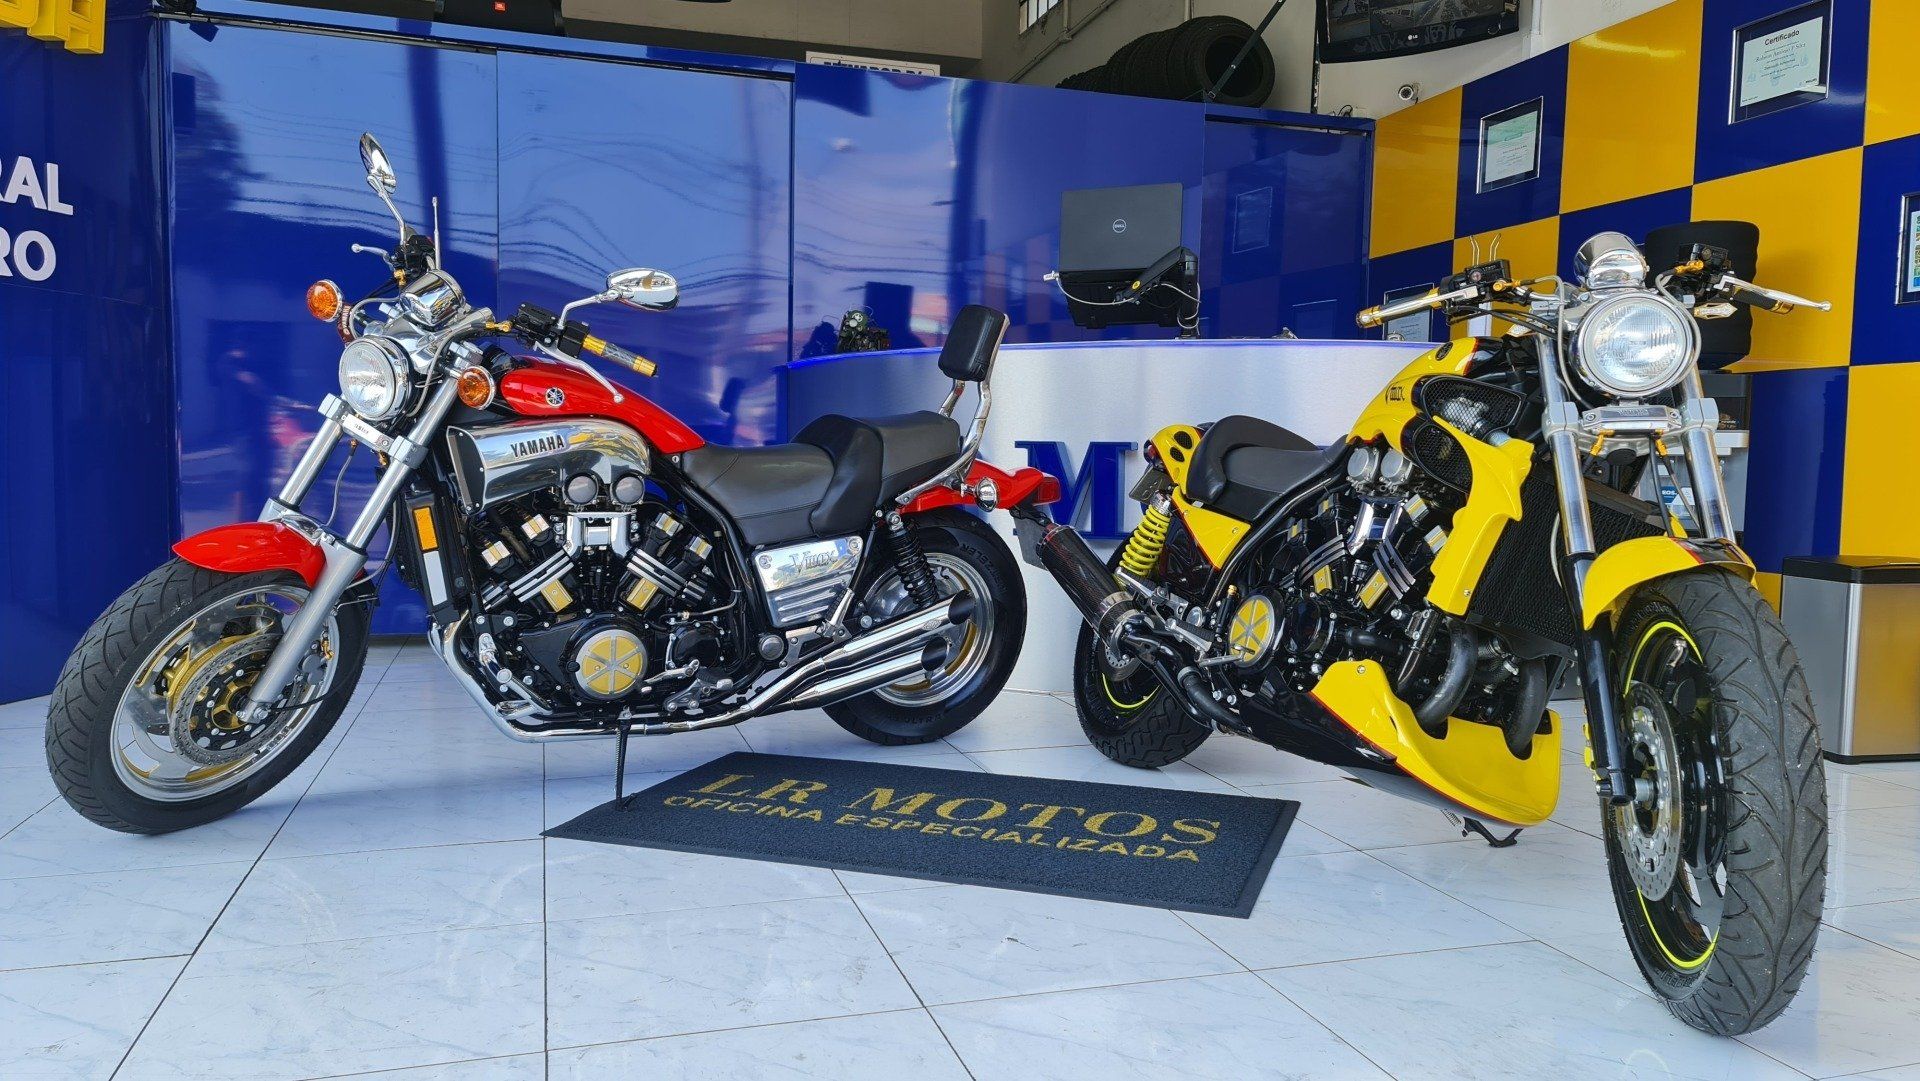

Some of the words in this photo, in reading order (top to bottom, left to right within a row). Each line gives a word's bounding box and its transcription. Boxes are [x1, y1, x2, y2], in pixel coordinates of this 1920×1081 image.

[1764, 30, 1800, 46] Certificado
[0, 155, 74, 216] AL
[510, 434, 565, 458] YAMAHA
[664, 795, 822, 822] OFICINA
[834, 813, 1200, 862] ESPECIALIZADA
[689, 773, 828, 804] LR
[842, 787, 1220, 845] MOTOS
